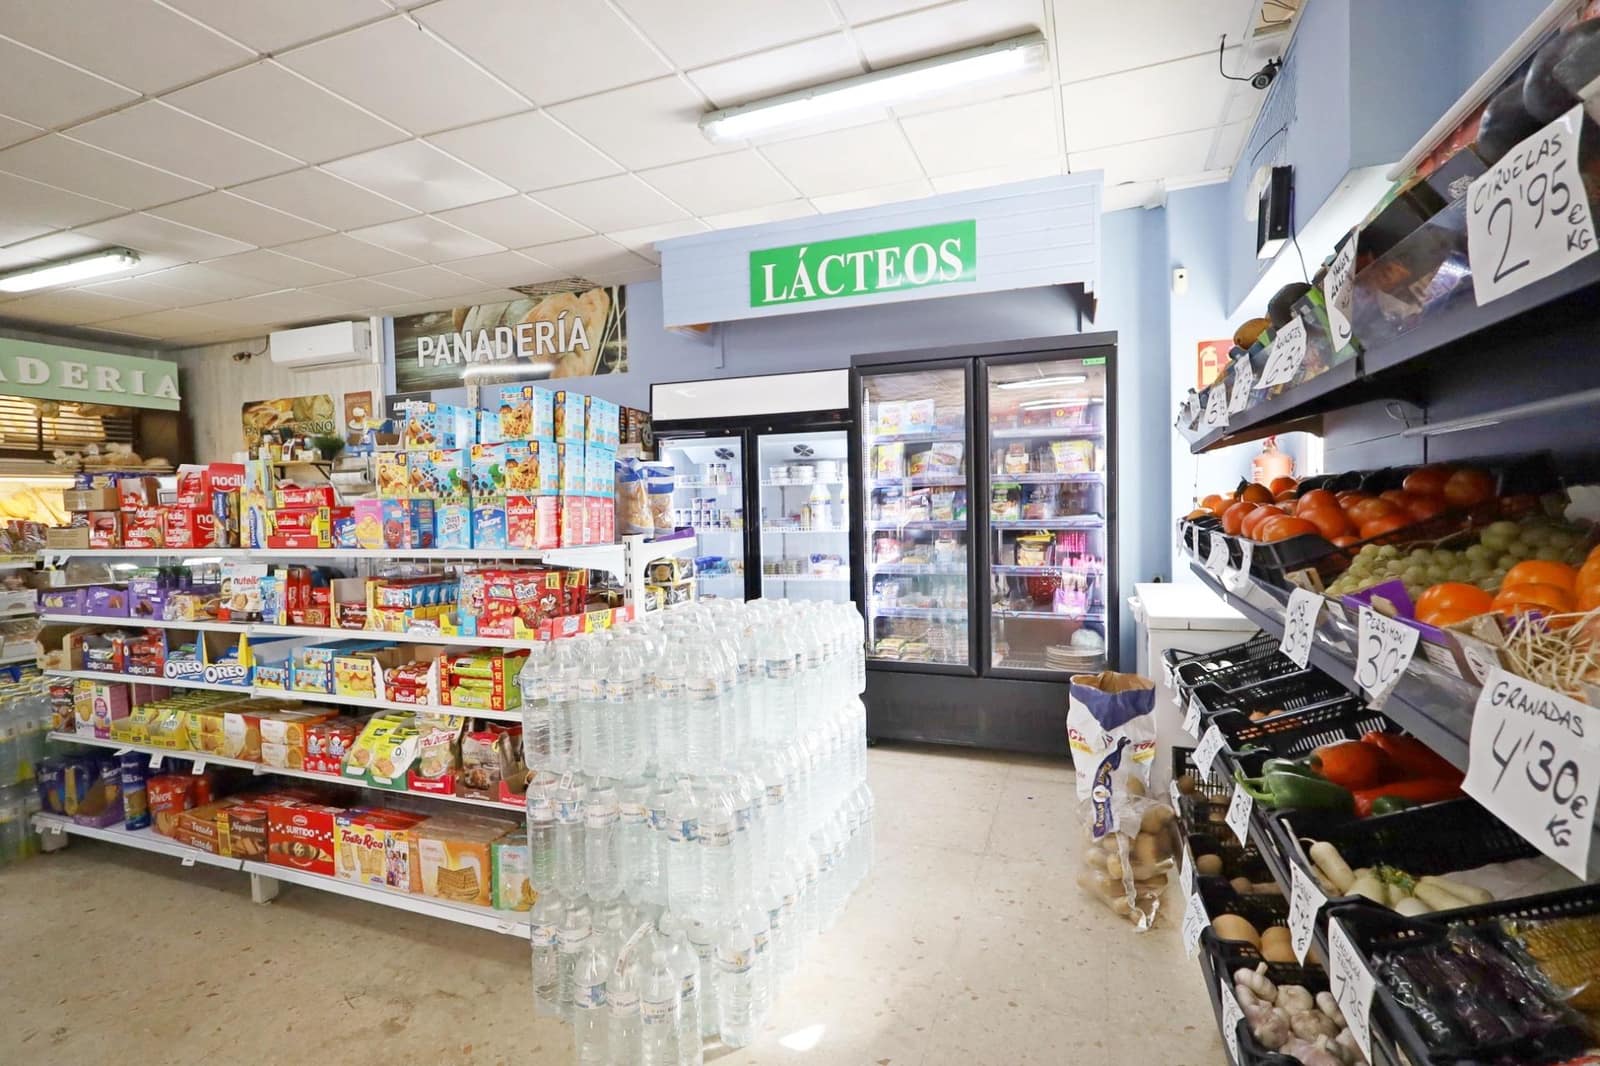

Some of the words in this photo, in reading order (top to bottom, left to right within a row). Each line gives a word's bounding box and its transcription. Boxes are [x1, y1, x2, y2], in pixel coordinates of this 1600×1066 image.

[1474, 134, 1563, 214] CIRUELAS
[1566, 229, 1592, 252] KG
[761, 237, 964, 304] LÁCTEOS
[416, 309, 591, 369] PANADERÍA
[212, 475, 246, 487] nocill
[164, 660, 203, 679] OREO
[204, 664, 246, 684] OREO
[1491, 681, 1584, 738] GRANADAS
[286, 826, 315, 838] SURTIDO
[341, 829, 362, 844] Tosta
[363, 834, 384, 850] Rica
[1545, 814, 1572, 848] KG
